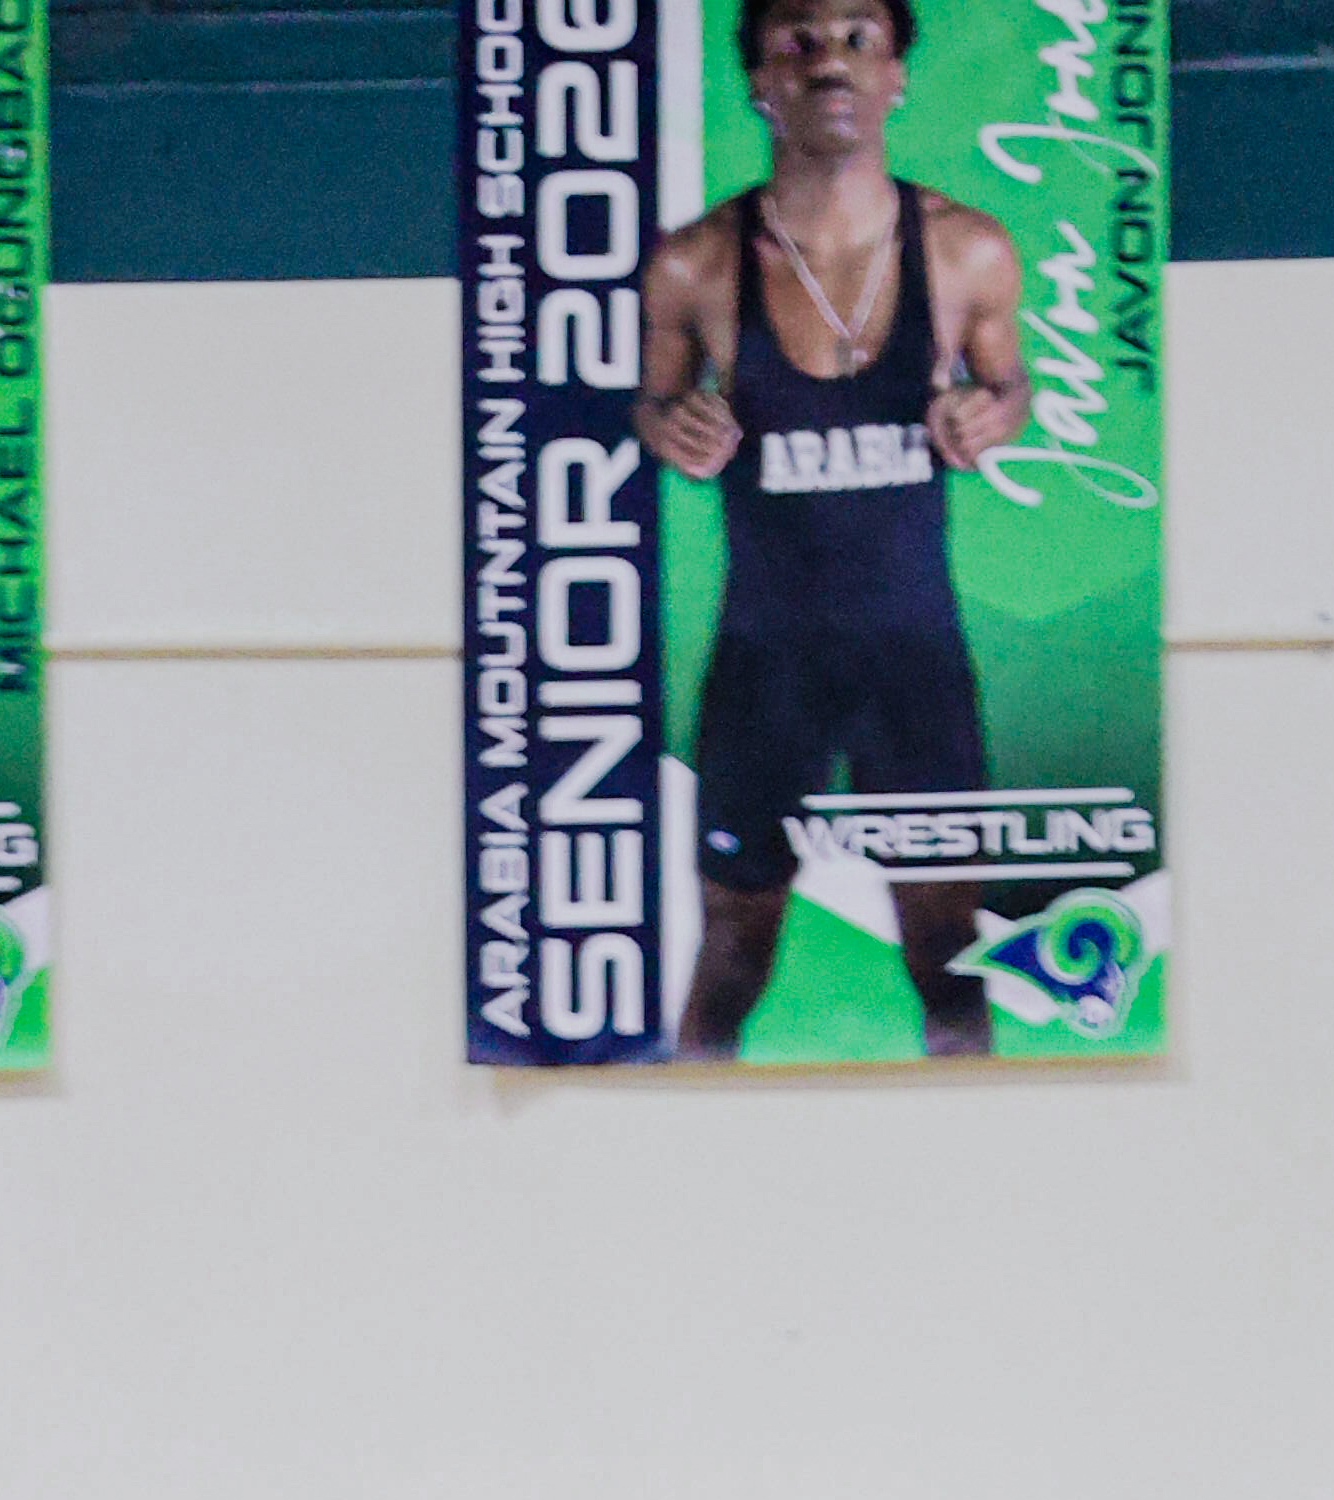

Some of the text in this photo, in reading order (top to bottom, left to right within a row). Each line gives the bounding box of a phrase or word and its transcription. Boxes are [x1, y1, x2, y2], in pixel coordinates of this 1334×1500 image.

[475, 233, 526, 384] HIGH
[1110, 0, 1157, 394] JAVON JON
[975, 219, 1159, 512] Javon
[476, 397, 529, 769] MOUTNTAIN
[535, 435, 646, 1041] SENIOR
[781, 808, 1157, 860] WRESTLING
[478, 781, 532, 1039] ARABIA
